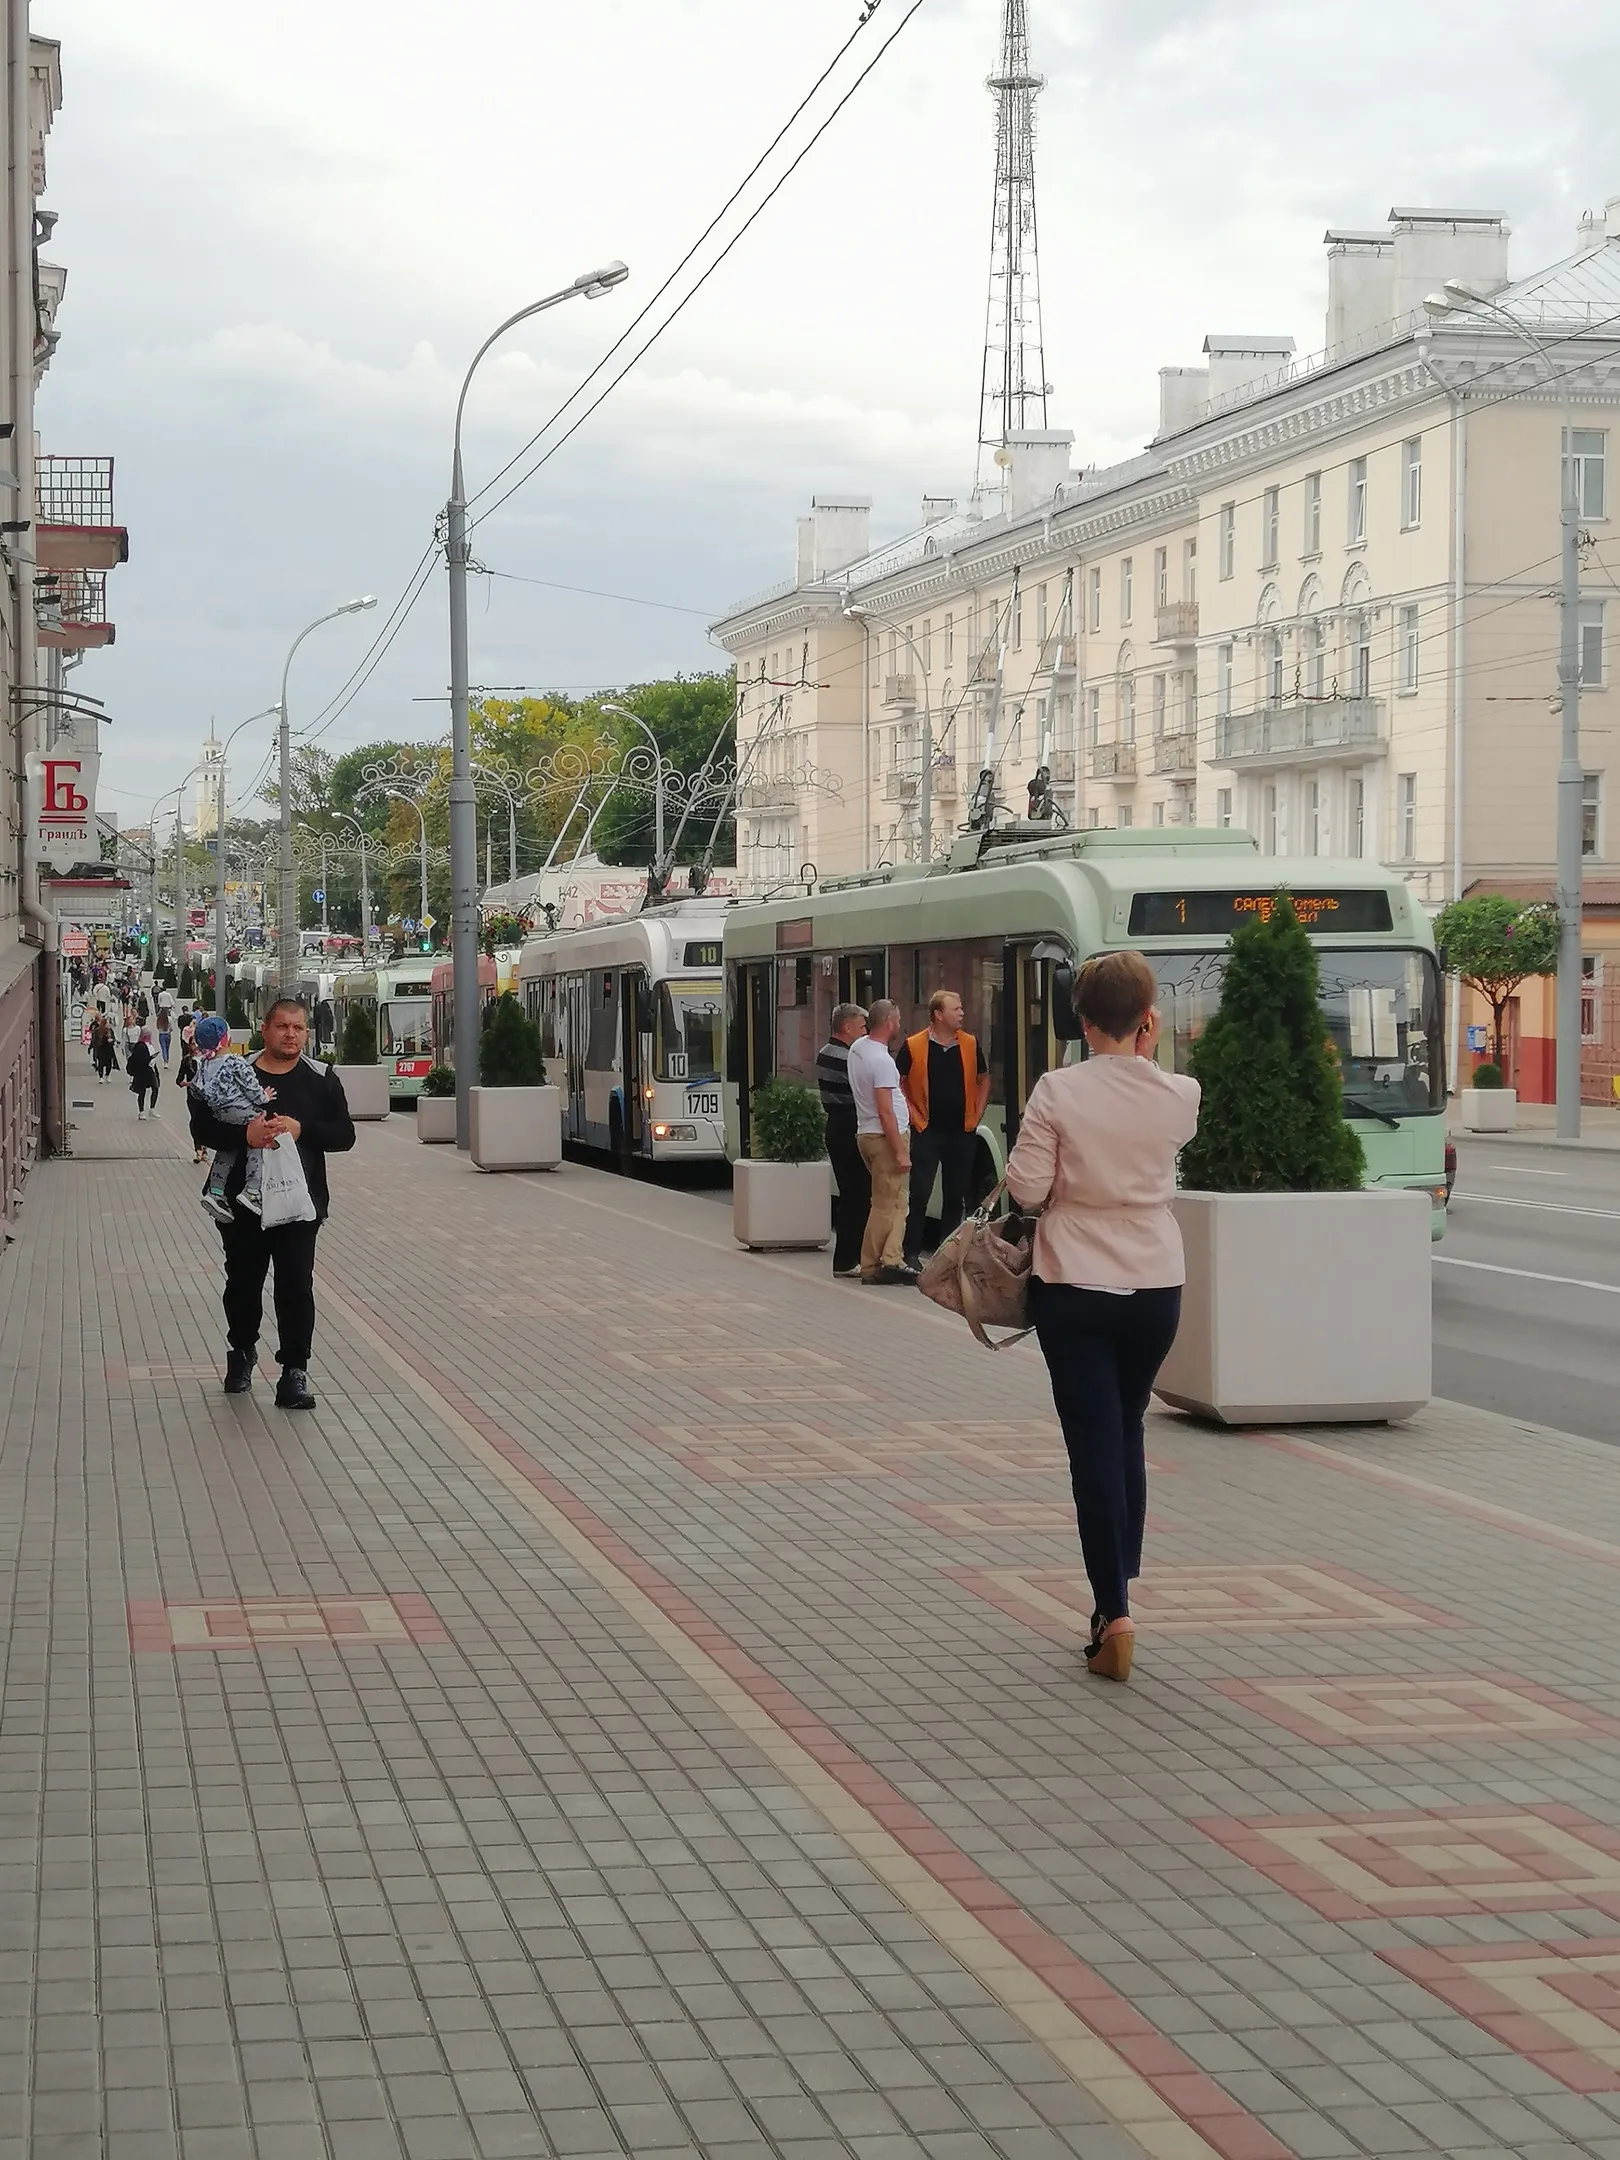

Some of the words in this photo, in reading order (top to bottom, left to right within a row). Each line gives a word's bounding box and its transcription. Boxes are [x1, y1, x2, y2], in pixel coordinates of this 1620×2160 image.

[1175, 898, 1185, 923] 1
[700, 946, 717, 964] 10
[395, 1043, 403, 1055] 2
[671, 1055, 686, 1077] 10
[687, 1094, 719, 1114] 1709
